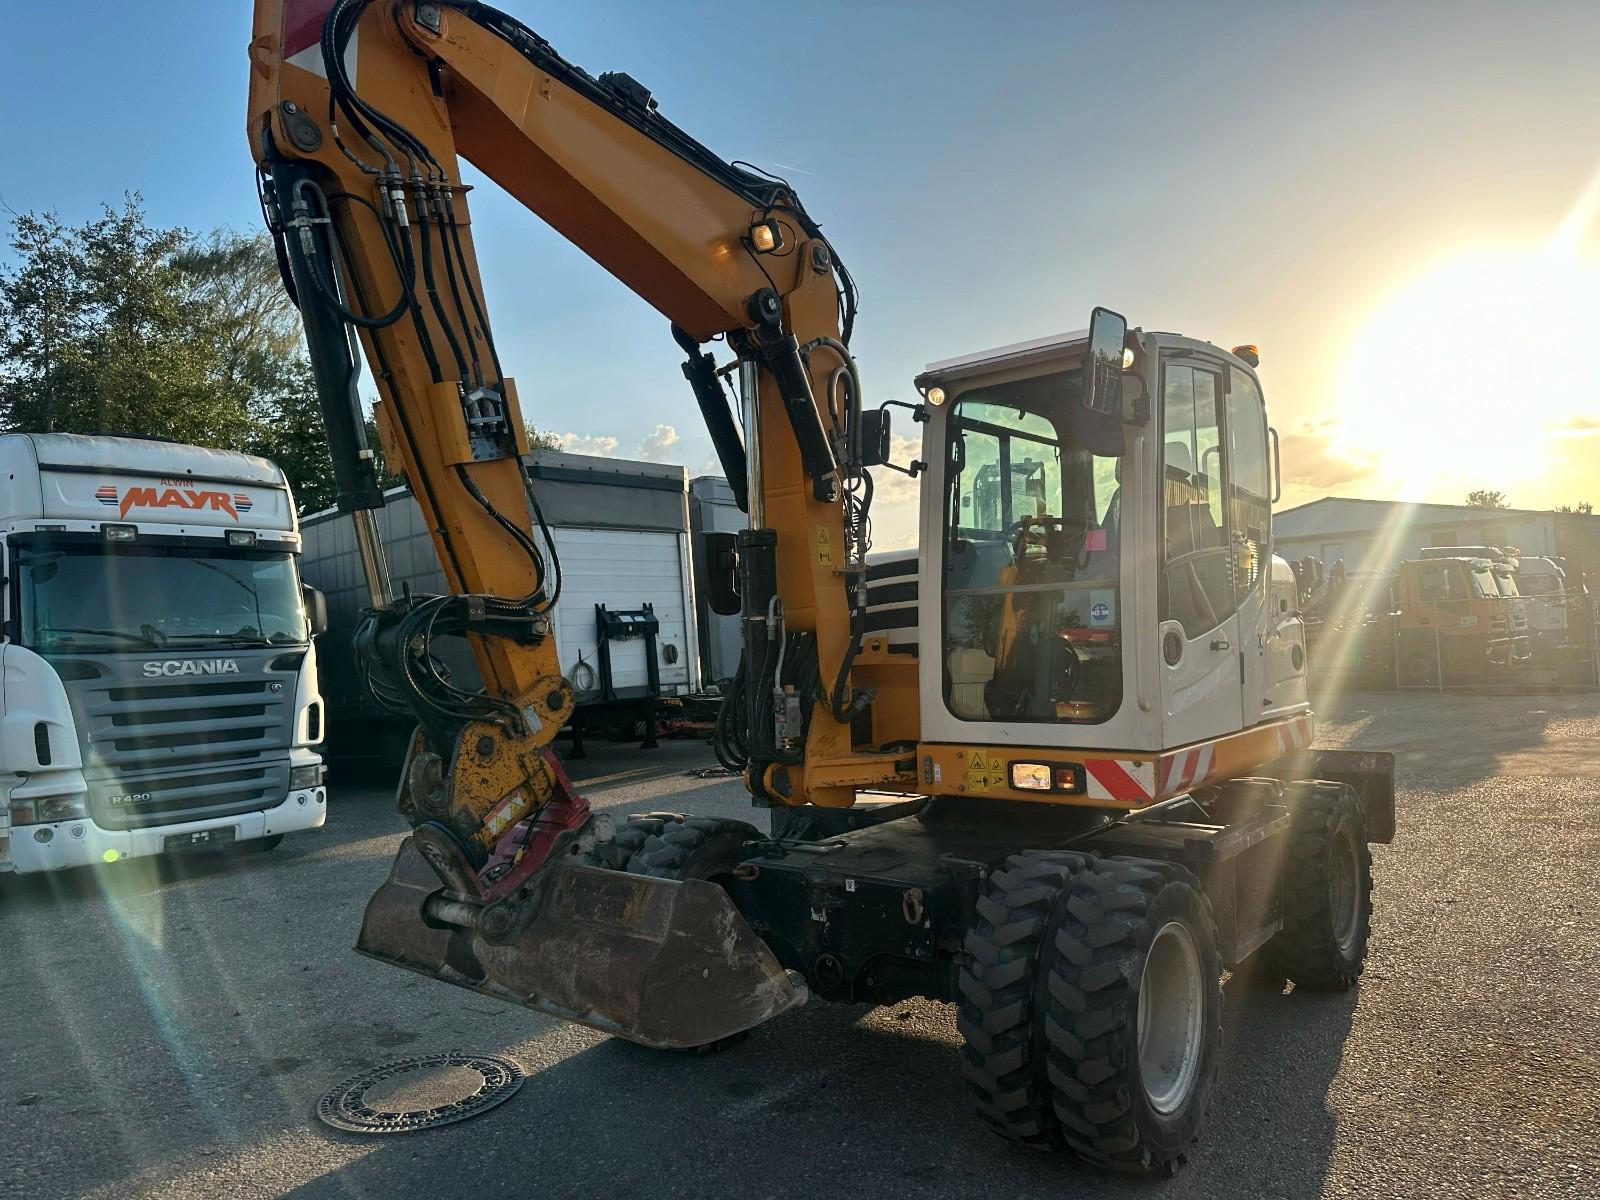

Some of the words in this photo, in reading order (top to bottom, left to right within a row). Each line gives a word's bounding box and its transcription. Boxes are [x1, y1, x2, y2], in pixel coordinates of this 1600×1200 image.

[160, 478, 193, 488] ALWIN
[119, 487, 239, 522] MAYR
[143, 659, 239, 677] SCANIA
